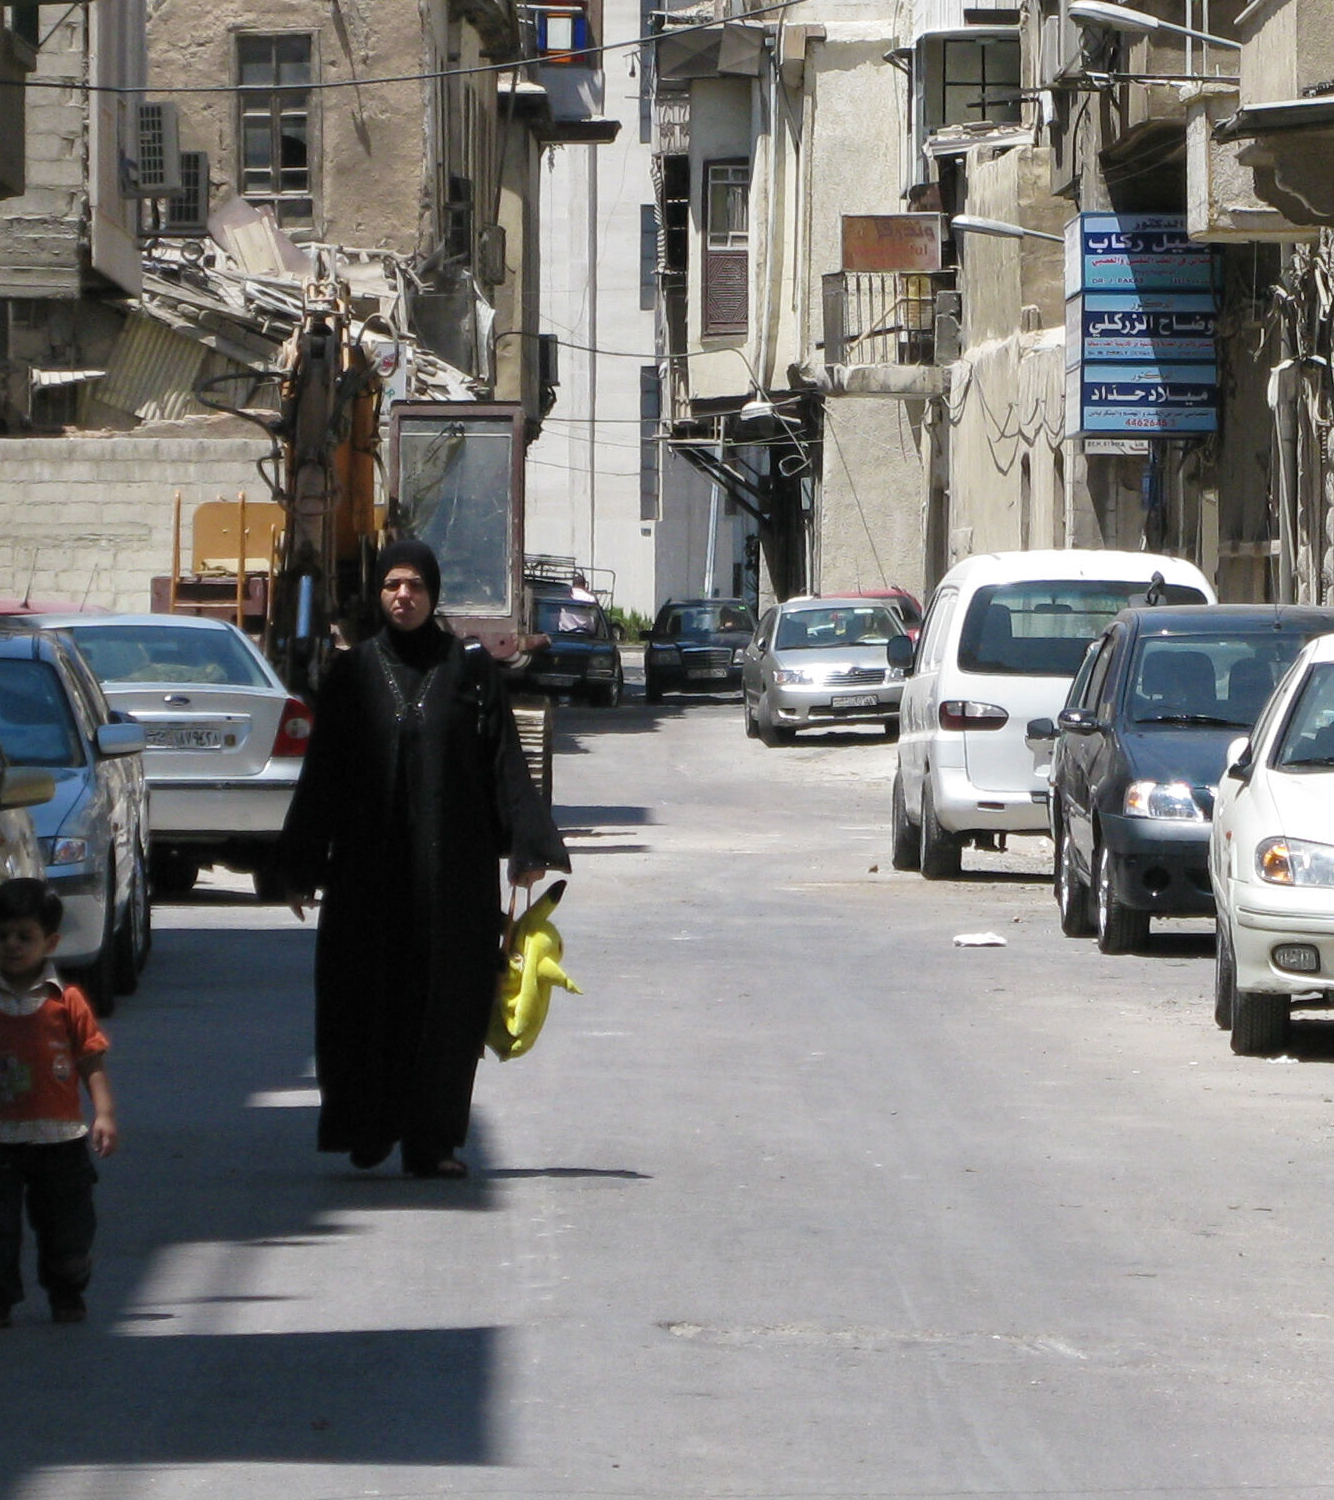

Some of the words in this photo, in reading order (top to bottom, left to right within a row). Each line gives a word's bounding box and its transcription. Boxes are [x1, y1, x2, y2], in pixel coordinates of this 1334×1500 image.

[1133, 216, 1185, 230] الدكتور
[1088, 233, 1144, 253] ركاب
[1088, 312, 1154, 337] الزركلي
[1158, 314, 1215, 336] وضاح
[1148, 386, 1209, 406] ميلاد
